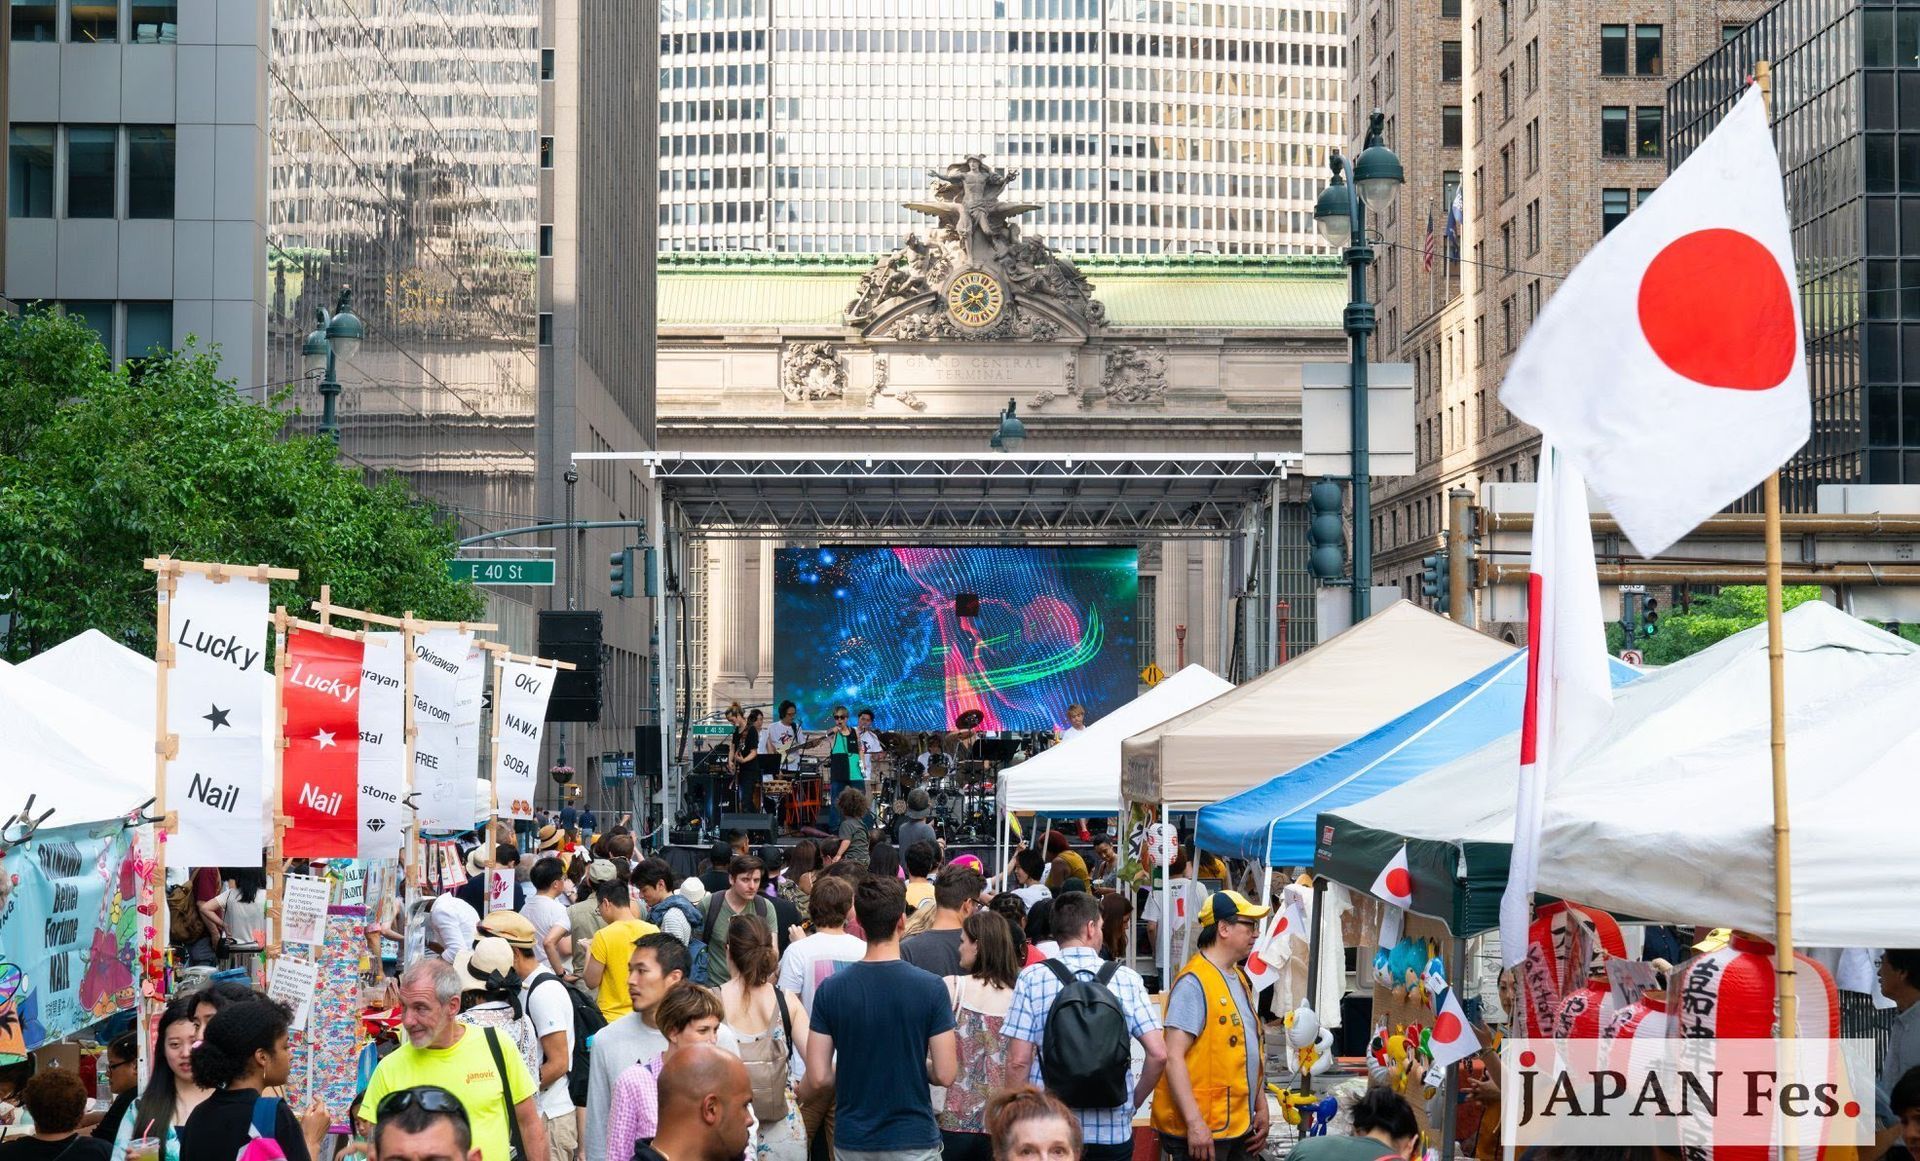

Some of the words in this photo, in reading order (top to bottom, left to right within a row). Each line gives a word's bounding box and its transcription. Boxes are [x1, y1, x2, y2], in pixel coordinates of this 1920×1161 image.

[906, 357, 961, 368] GRAND
[971, 357, 1042, 368] CENTRAL
[936, 369, 1013, 380] TERMINAL
[471, 564, 479, 579] E
[484, 564, 503, 579] 40
[508, 564, 523, 579] St
[178, 619, 259, 671] Lucky
[415, 645, 460, 675] Okinawan
[290, 663, 358, 703] Lucky
[514, 673, 542, 695] OKI
[413, 694, 428, 712] Tea
[428, 702, 451, 723] room
[505, 713, 538, 740] NAWA
[415, 751, 439, 770] FREE
[504, 754, 529, 778] SOBA
[187, 773, 240, 813] Nail
[299, 782, 343, 816] Nail
[362, 784, 397, 804] stone
[52, 883, 79, 914] Better
[44, 917, 79, 949] Fortune
